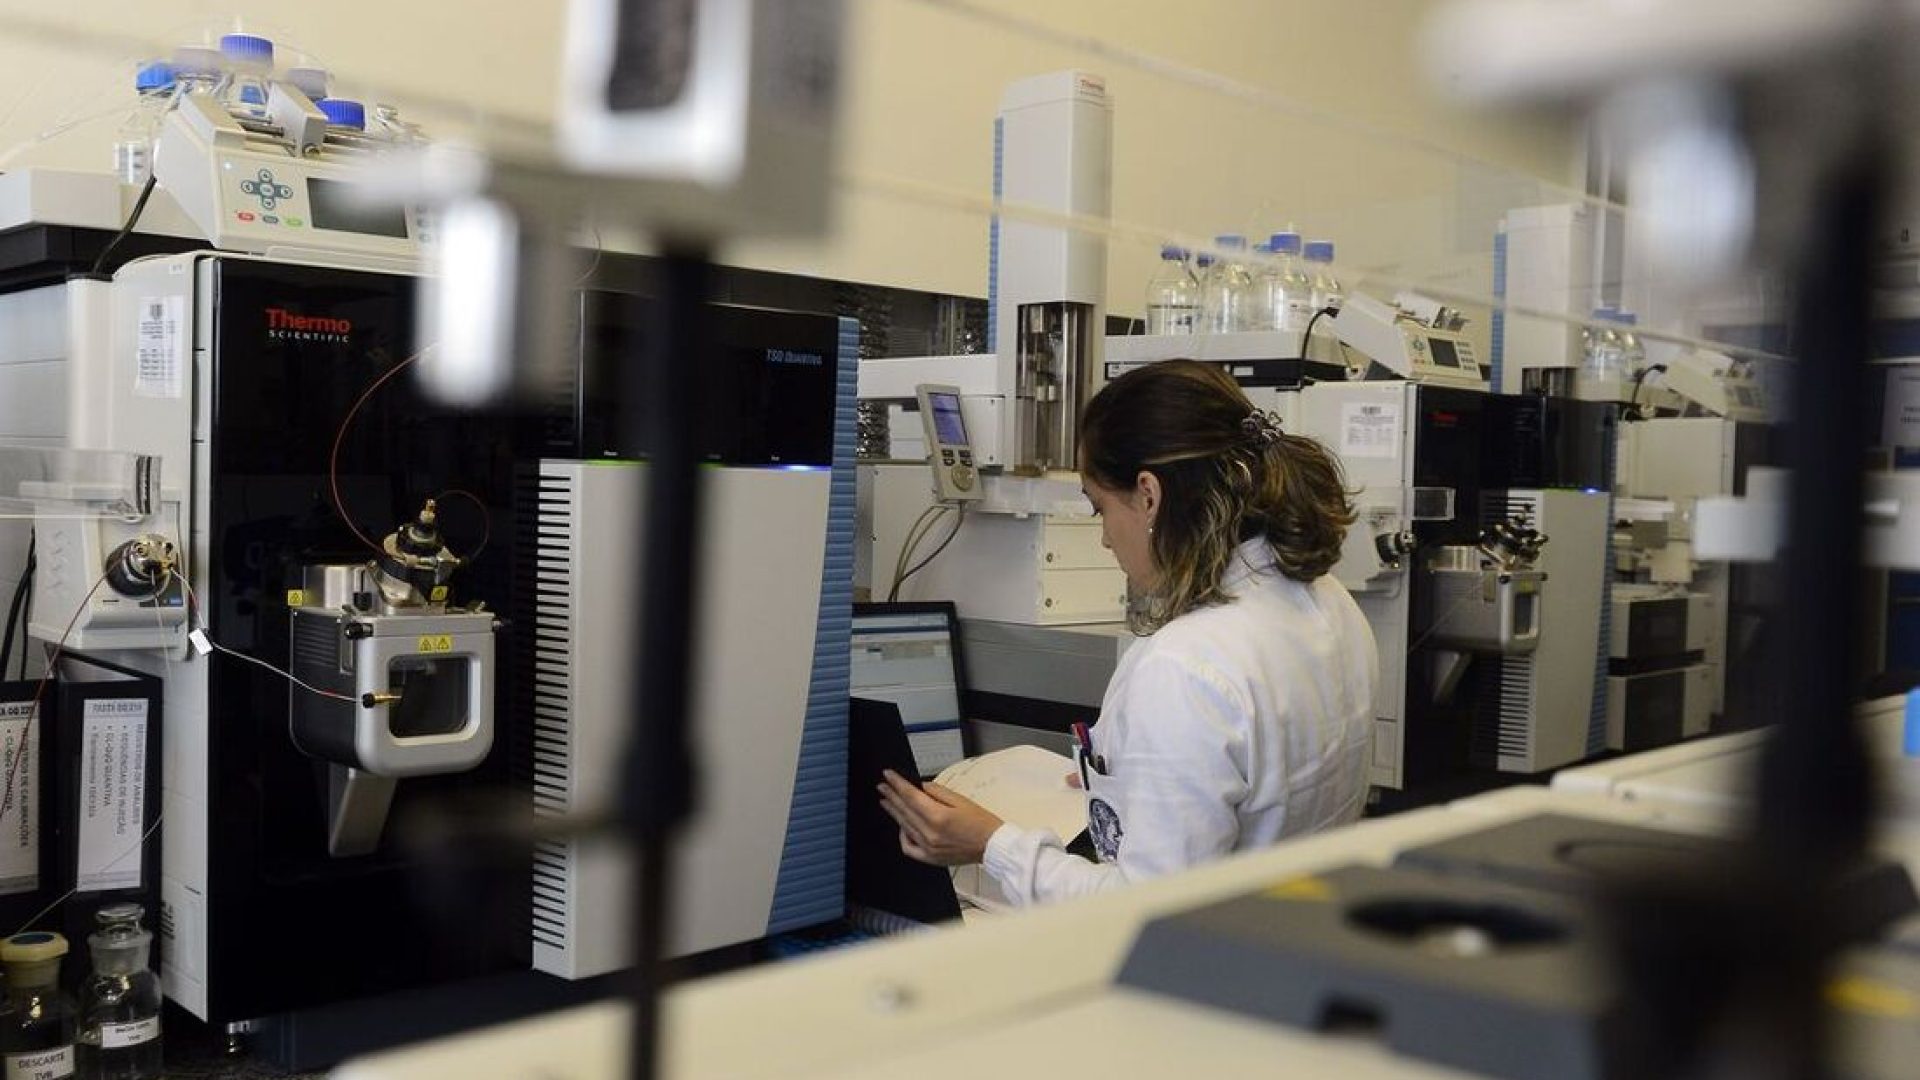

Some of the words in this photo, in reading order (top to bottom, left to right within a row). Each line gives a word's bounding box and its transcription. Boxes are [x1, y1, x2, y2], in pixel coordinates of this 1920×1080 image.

[265, 307, 351, 334] Thermo
[268, 329, 350, 343] SCIENTIFIC
[18, 1052, 65, 1069] DESCARTE
